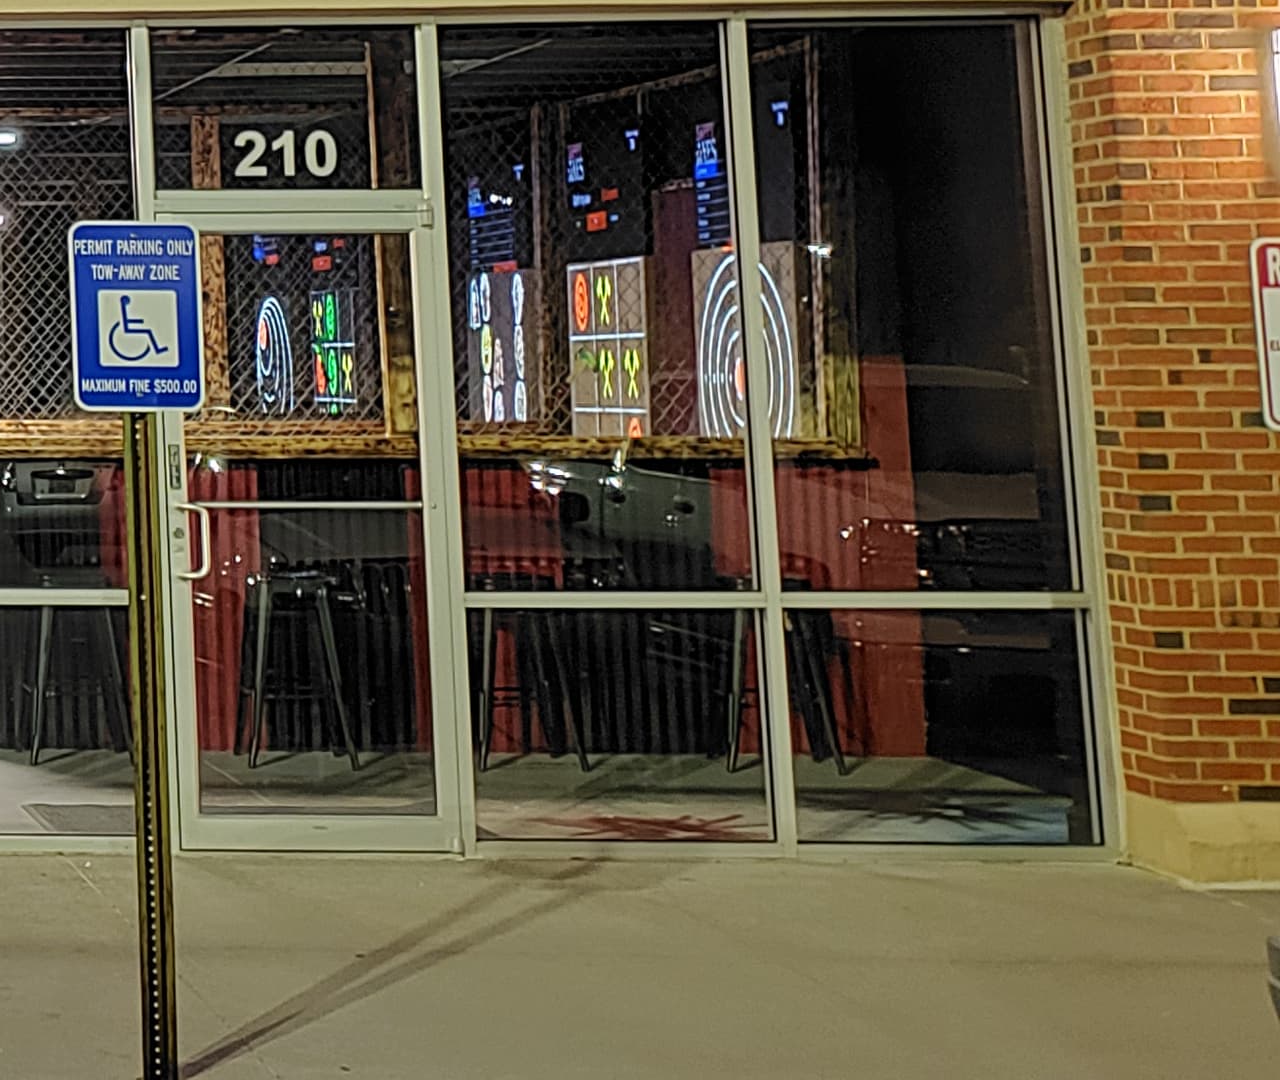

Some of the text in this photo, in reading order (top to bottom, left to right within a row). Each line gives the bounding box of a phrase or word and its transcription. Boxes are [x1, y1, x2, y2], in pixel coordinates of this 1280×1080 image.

[234, 129, 338, 177] 210
[74, 239, 194, 256] PERMIT PARKING ONLY
[91, 264, 181, 281] TOW-AWAY ZONE
[82, 378, 197, 394] MAXIMUM FINE $500.00
